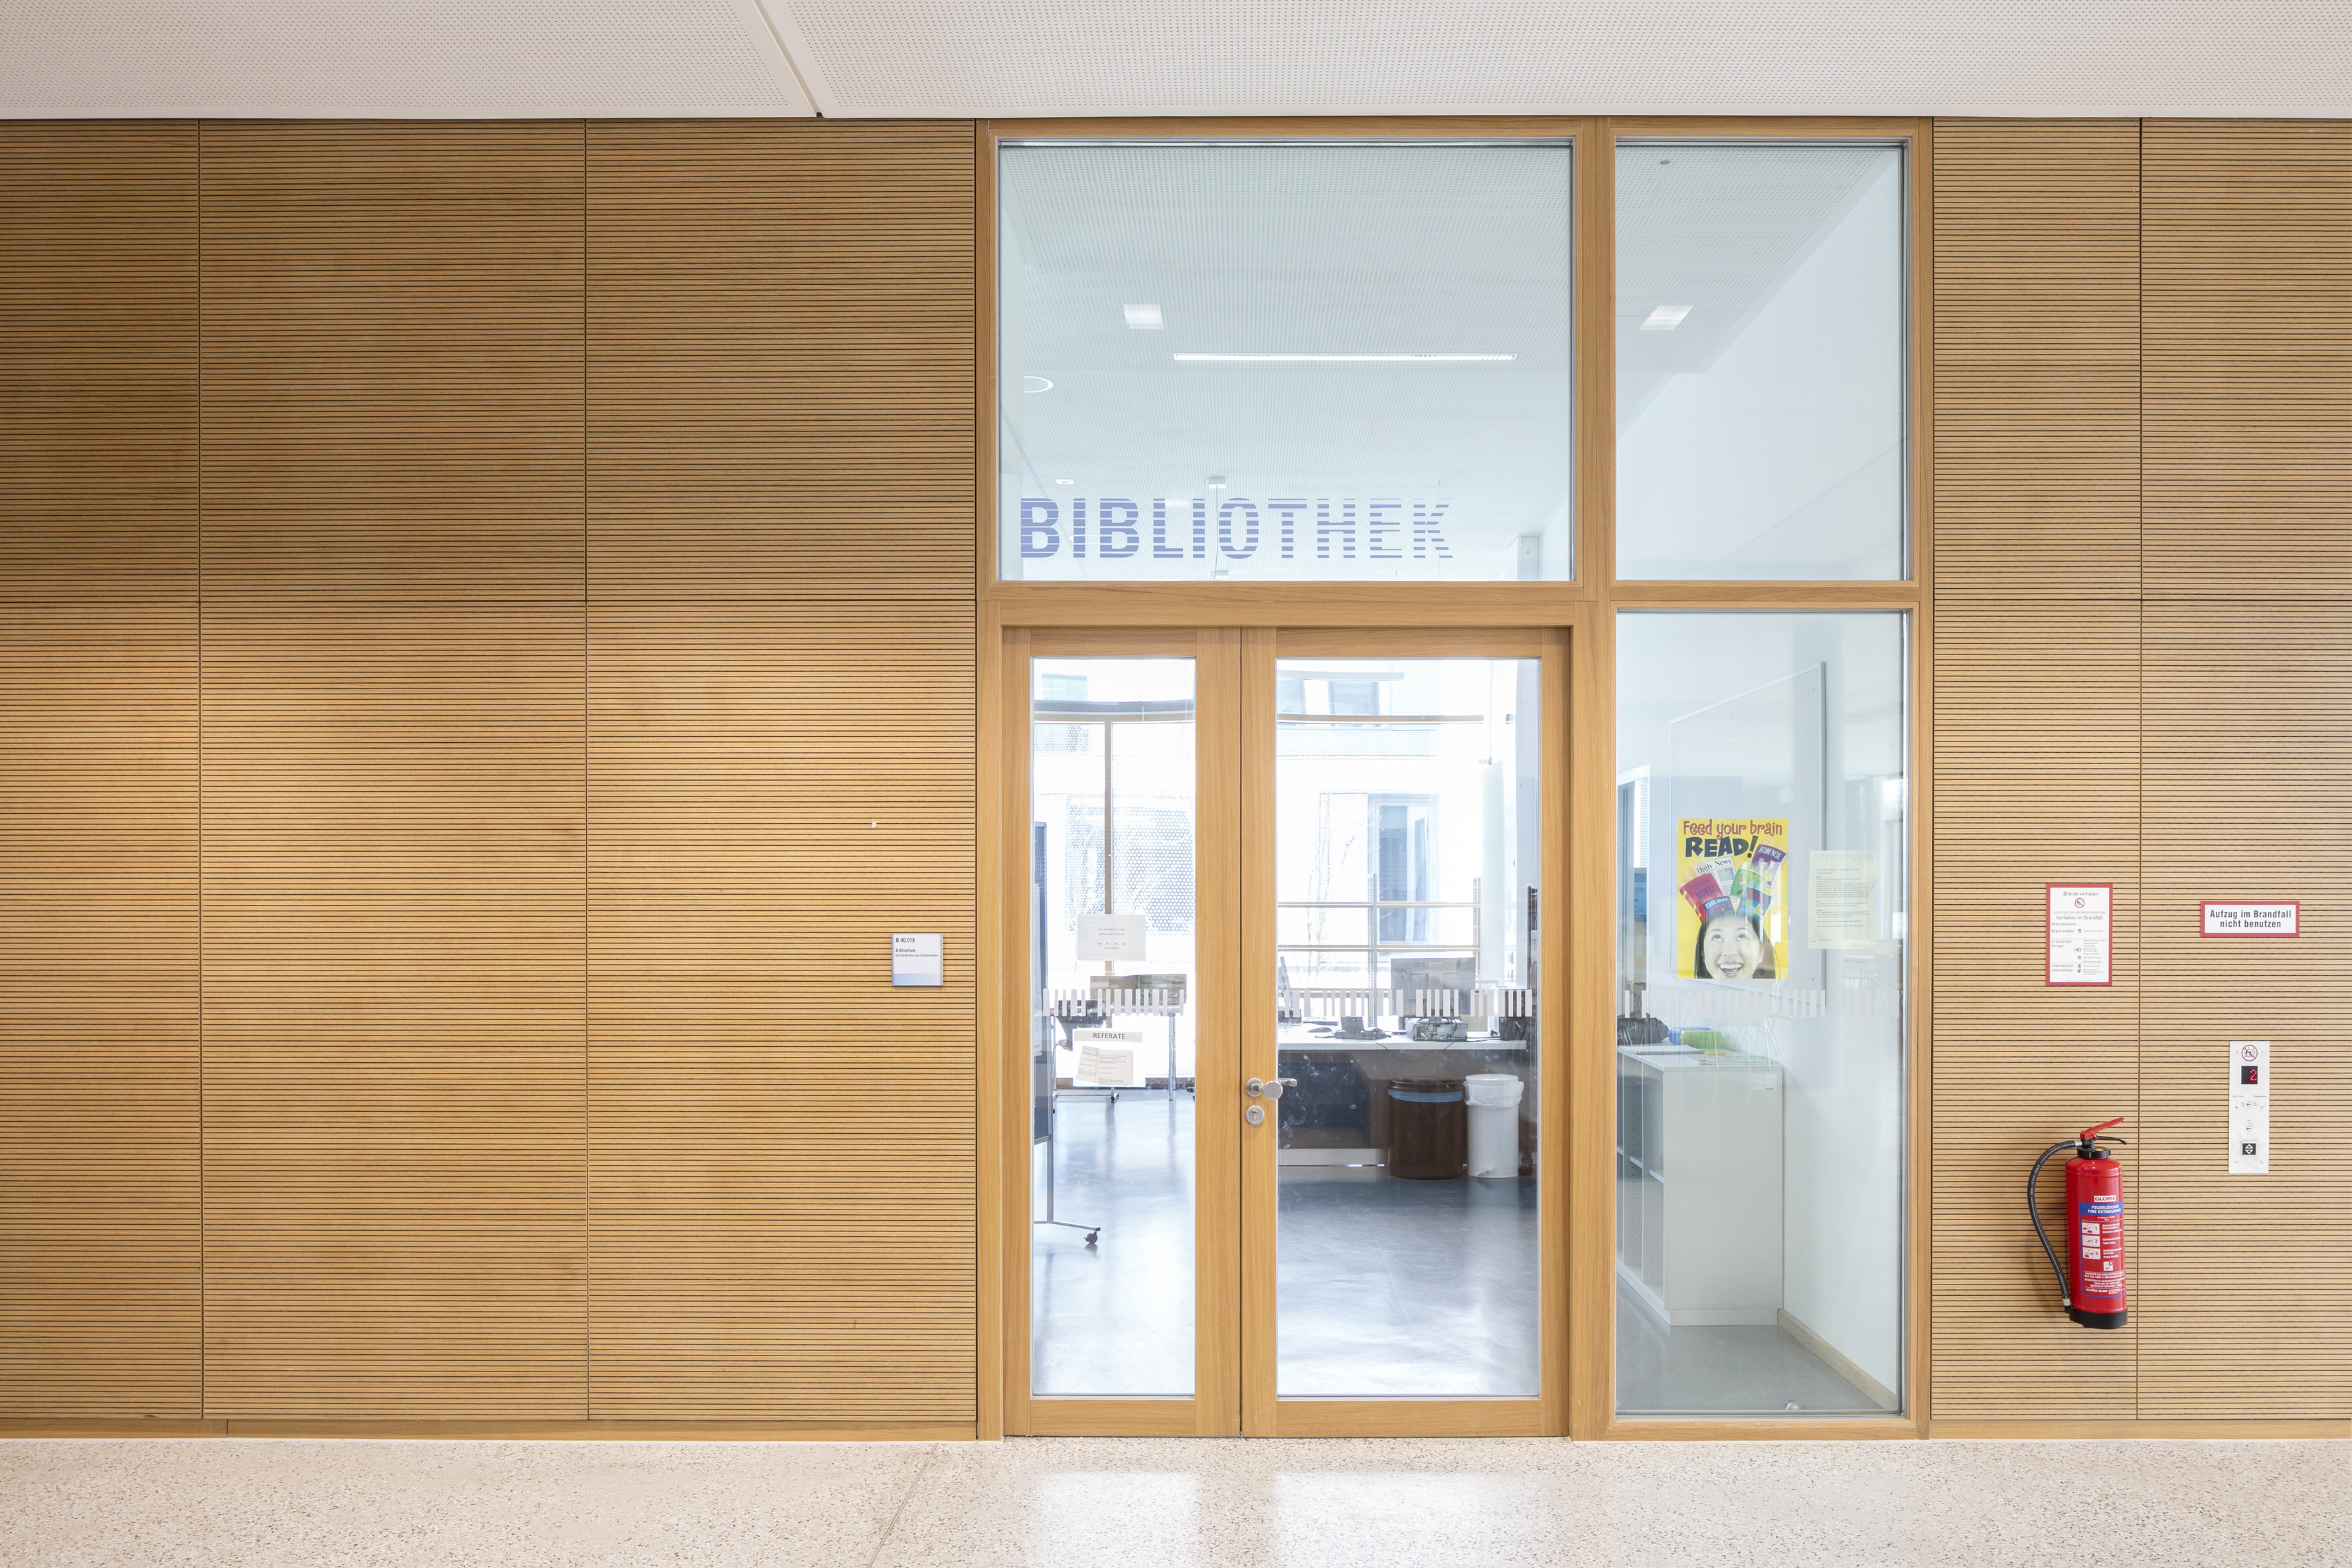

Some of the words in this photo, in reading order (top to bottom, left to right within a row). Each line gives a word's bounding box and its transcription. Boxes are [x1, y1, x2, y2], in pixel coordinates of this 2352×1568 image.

[1020, 498, 1454, 559] BIBLIOTHEK
[1684, 819, 1712, 836] Feed
[1716, 823, 1747, 840] your
[1750, 819, 1782, 836] brain
[1685, 835, 1759, 858] READ!
[1759, 846, 1783, 860] SCIENCE
[1696, 864, 1713, 874] Daily
[1714, 859, 1732, 868] News
[1693, 878, 1711, 890] Greatest
[1695, 884, 1717, 902] NOVEL
[1704, 901, 1717, 909] COOL
[2209, 910, 2238, 919] Aufzug
[2250, 1069, 2257, 1081] 2
